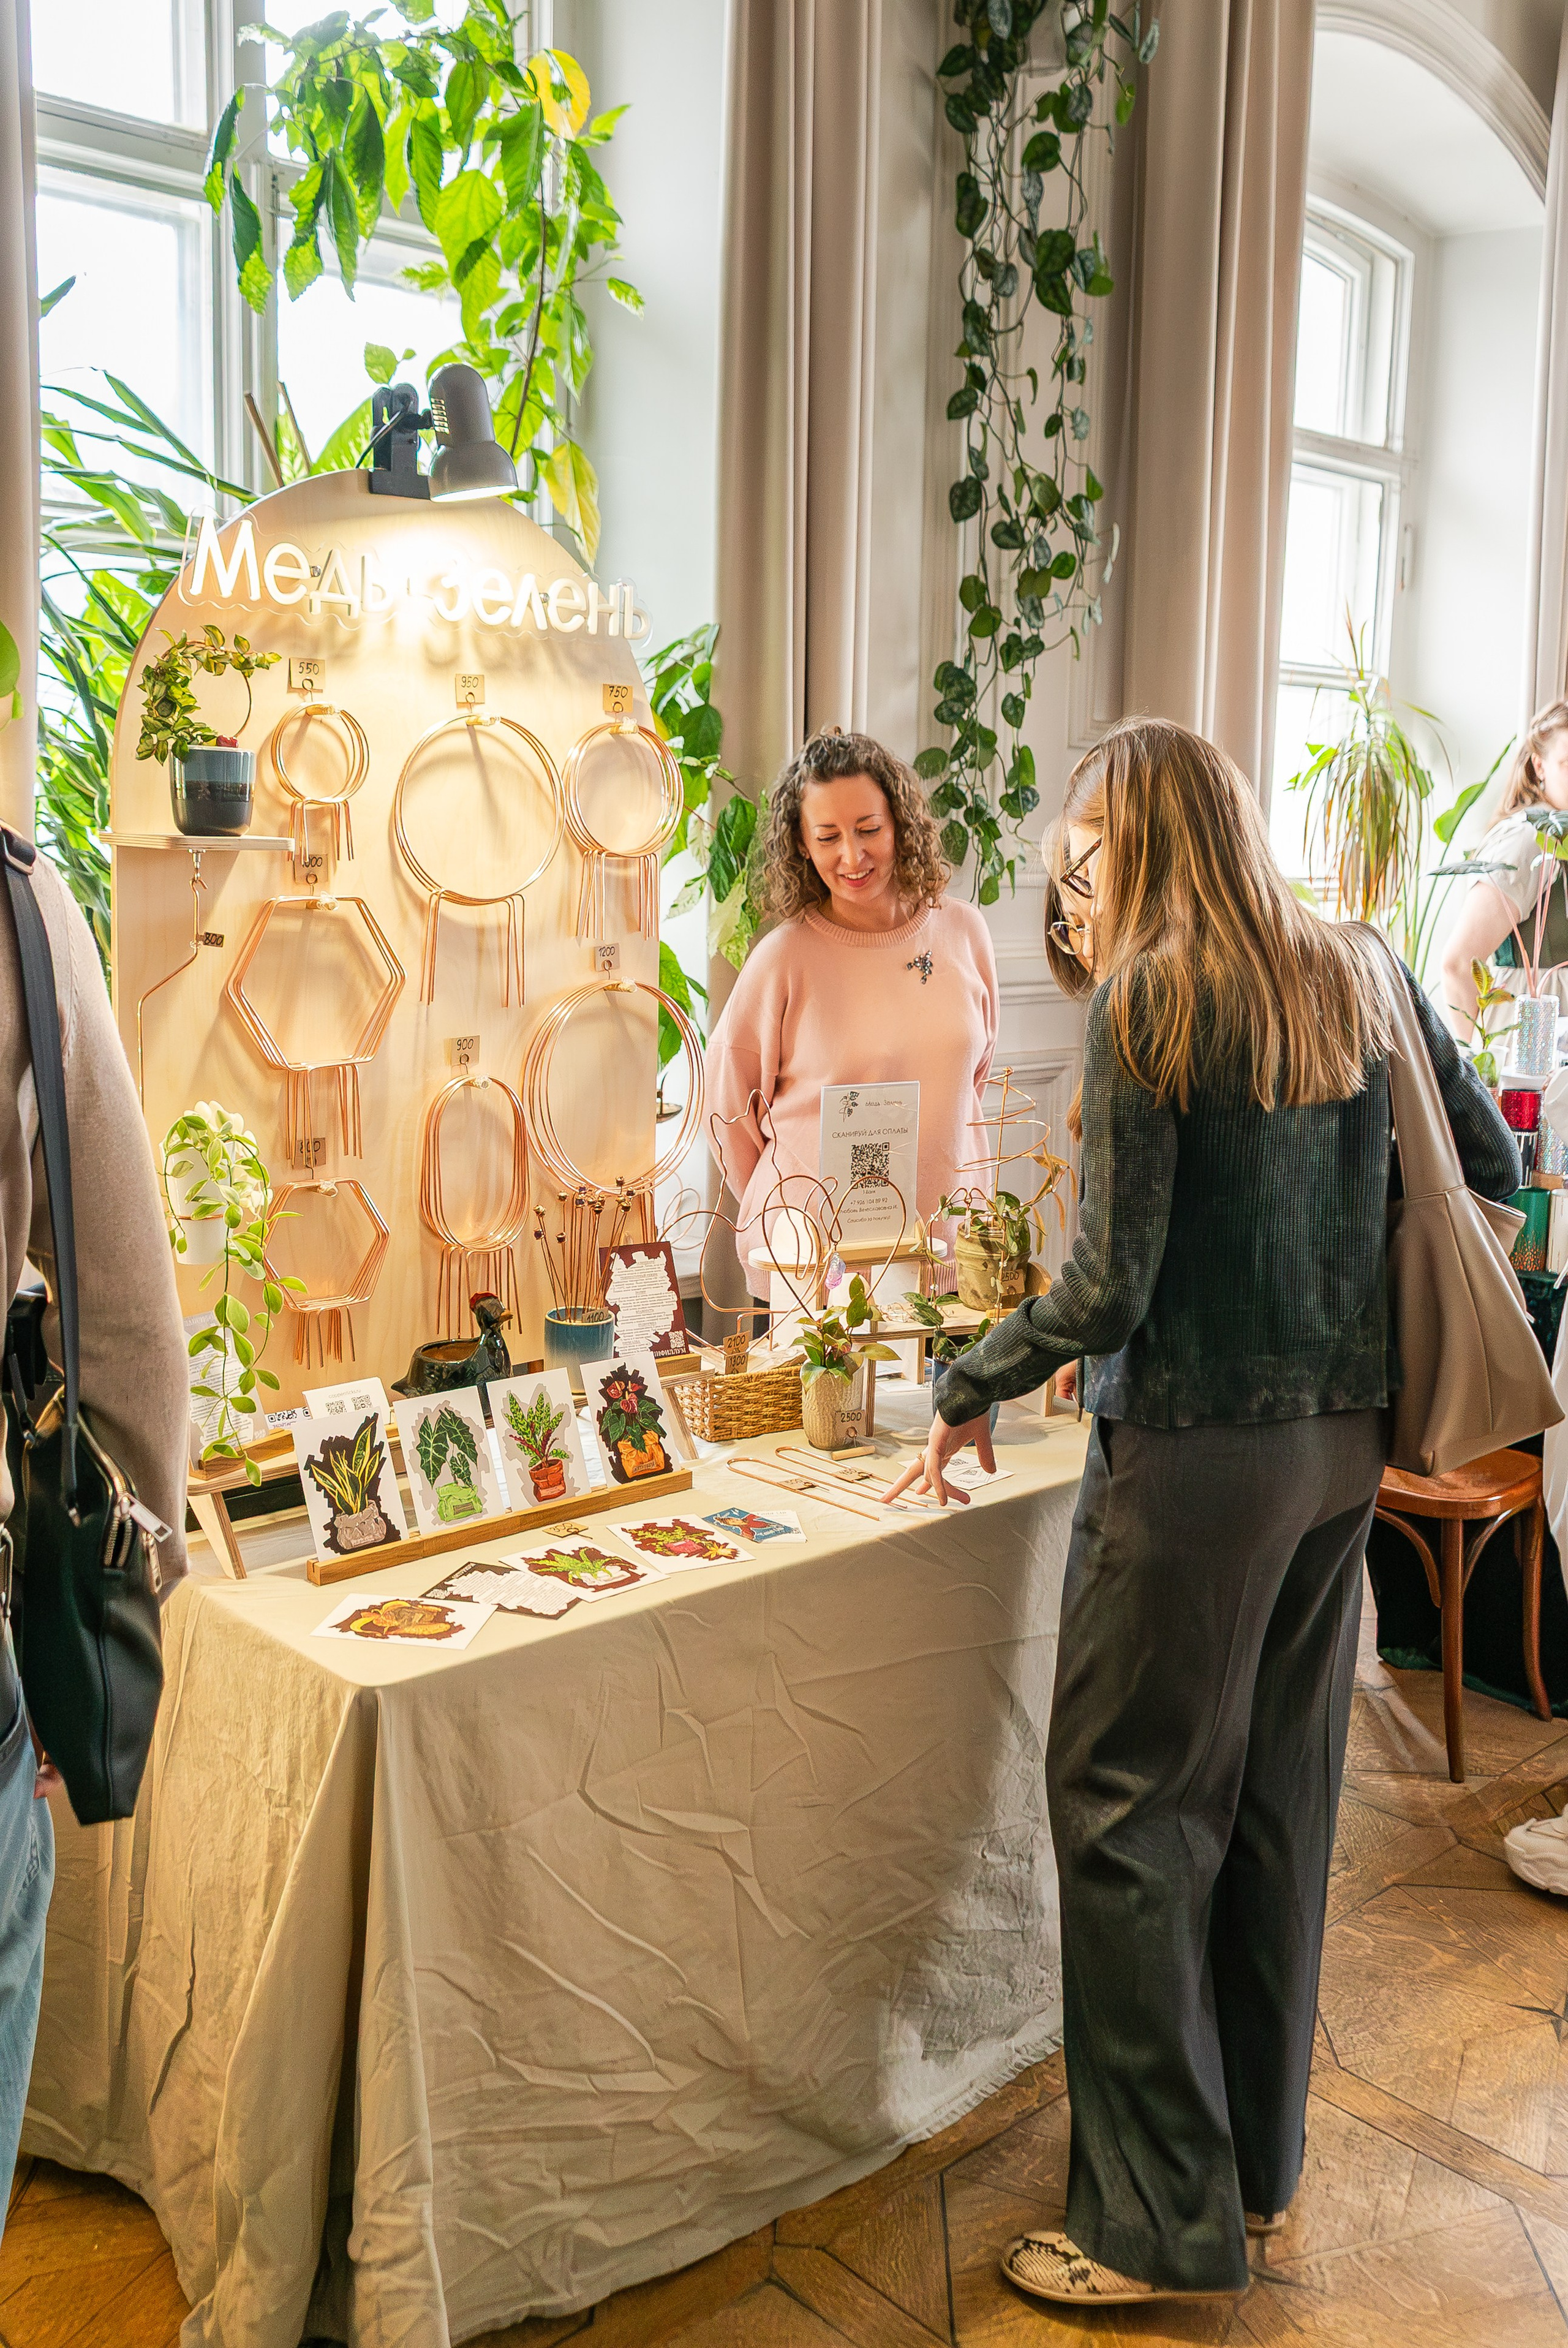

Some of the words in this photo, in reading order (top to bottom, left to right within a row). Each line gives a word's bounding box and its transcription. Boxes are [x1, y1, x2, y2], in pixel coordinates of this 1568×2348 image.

[189, 515, 394, 619] Медь
[432, 551, 651, 640] Зелень
[298, 662, 319, 675] 550
[461, 676, 479, 688] 950
[609, 685, 628, 698] 750
[303, 856, 323, 868] 000
[205, 932, 223, 946] 800
[598, 946, 616, 957] 1200
[456, 1038, 474, 1051] 900
[832, 1129, 867, 1139] СКАНИРУЙ
[587, 1311, 605, 1323] 1100
[727, 1335, 746, 1348] 2100
[729, 1355, 745, 1367] 1300
[840, 1411, 862, 1423] 2500
